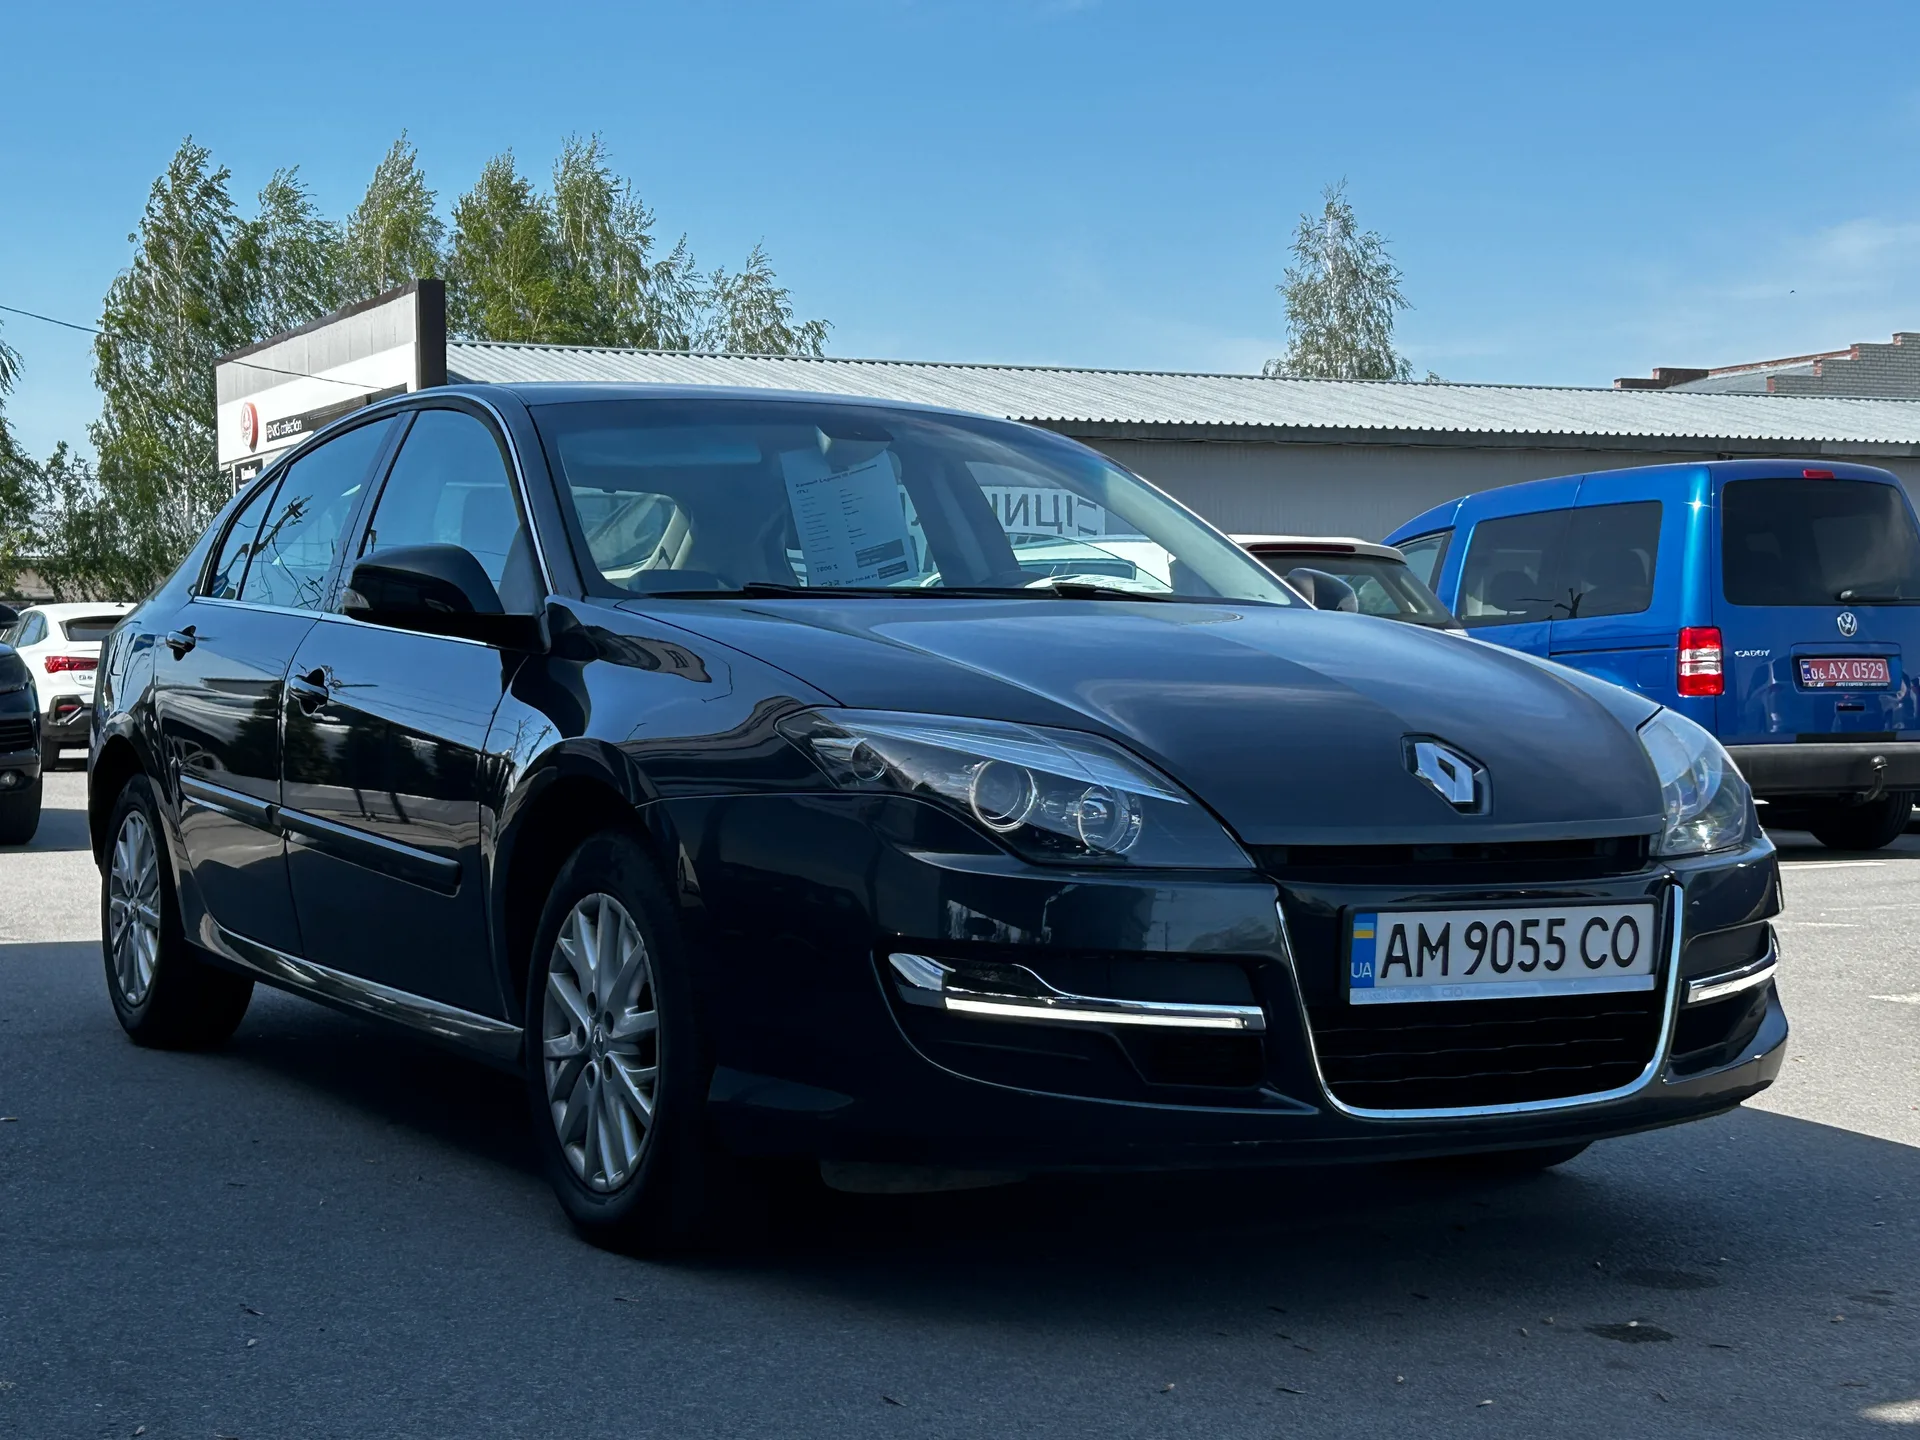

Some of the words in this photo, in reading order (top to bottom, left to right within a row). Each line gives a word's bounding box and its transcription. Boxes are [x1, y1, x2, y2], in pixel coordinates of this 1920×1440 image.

[1811, 667, 1826, 680] 06
[1828, 662, 1849, 679] AX
[1852, 662, 1884, 679] 0529
[1380, 922, 1451, 979] AM
[1463, 918, 1566, 976] 9055
[1580, 915, 1640, 970] CO
[1351, 962, 1373, 979] UA
